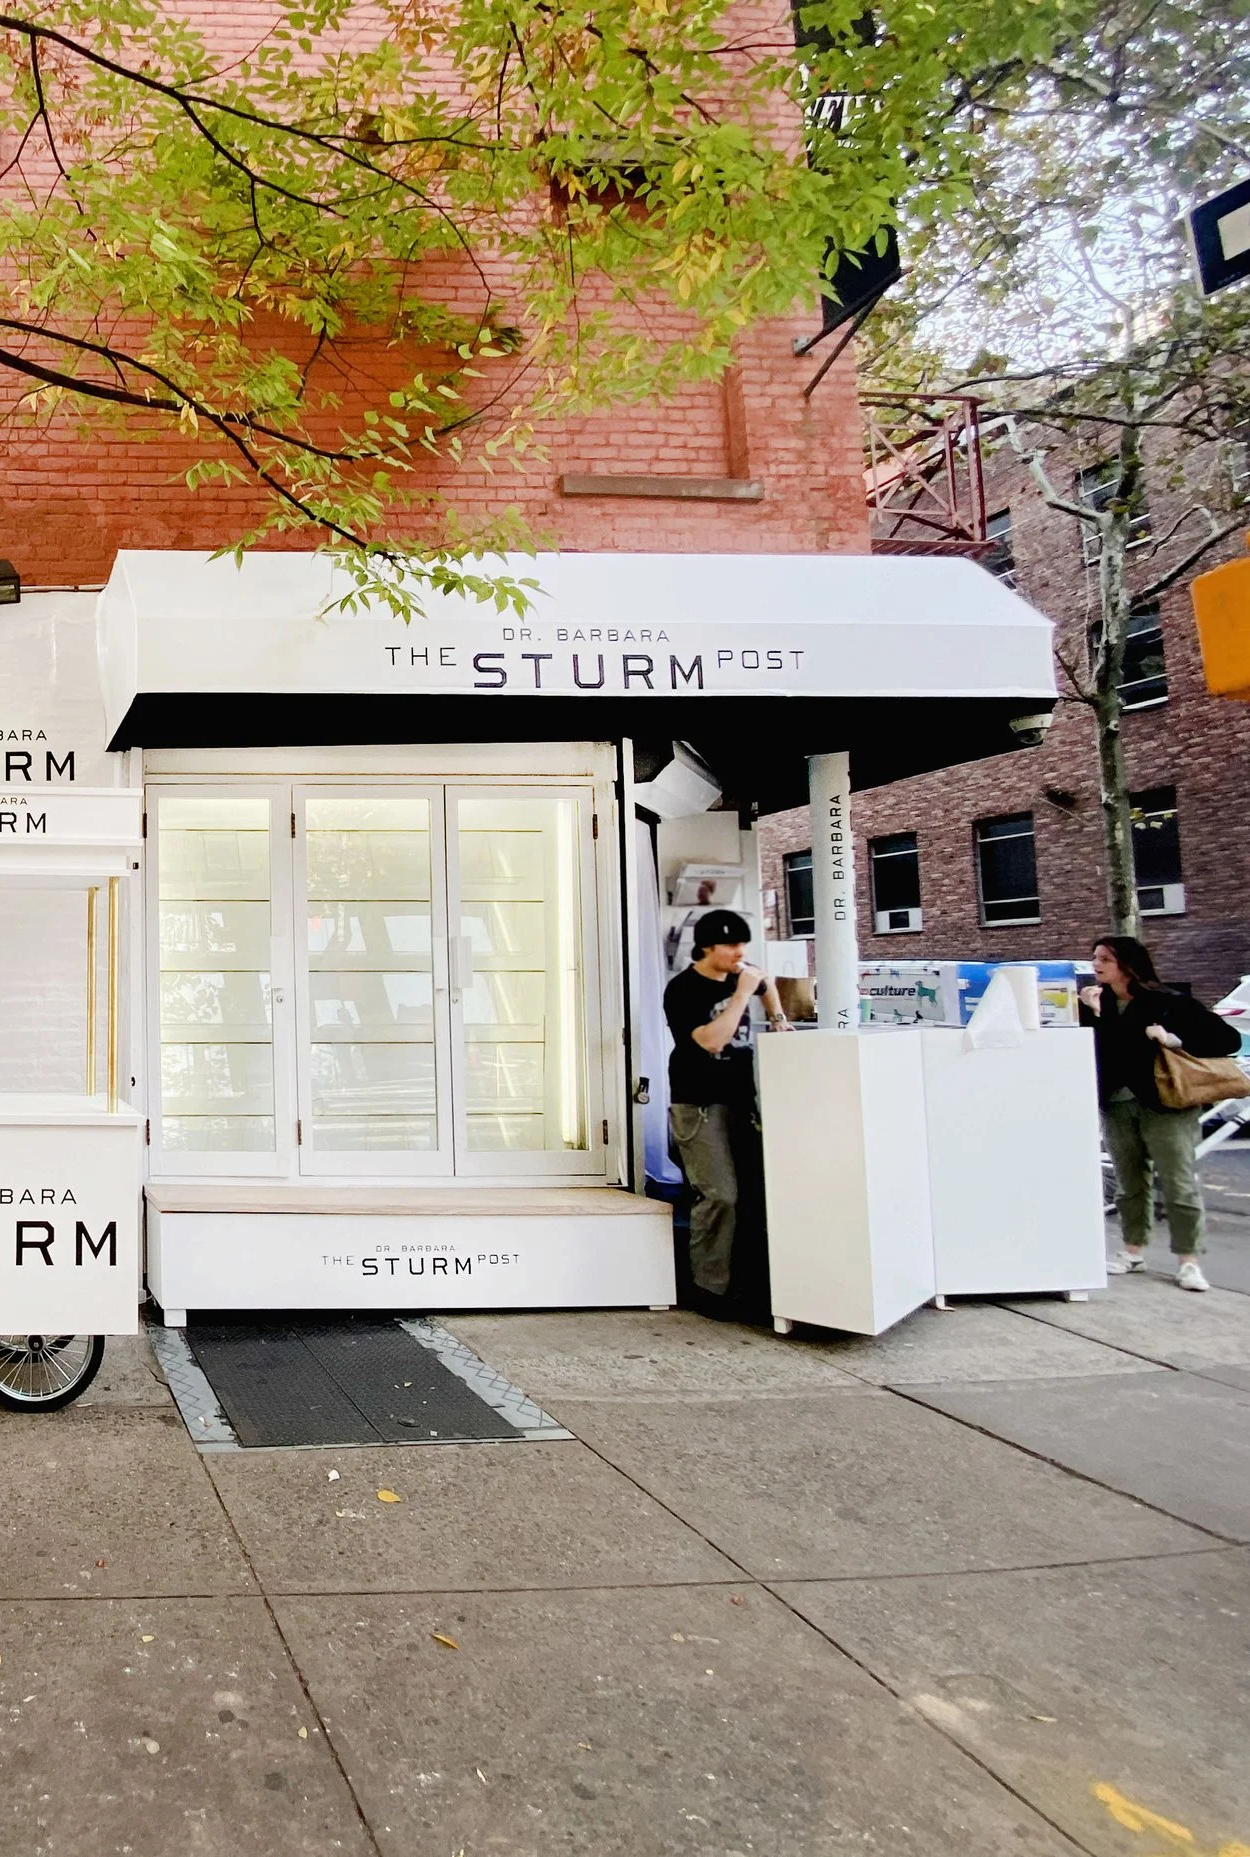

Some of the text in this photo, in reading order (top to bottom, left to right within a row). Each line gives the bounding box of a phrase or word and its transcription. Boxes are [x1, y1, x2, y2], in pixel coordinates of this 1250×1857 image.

[503, 628, 669, 642] DR. BARBARA
[385, 647, 804, 689] THE STURM POST
[829, 794, 846, 921] DR. BARBARA
[869, 985, 916, 996] culture
[322, 1254, 519, 1275] THE STURM POST
